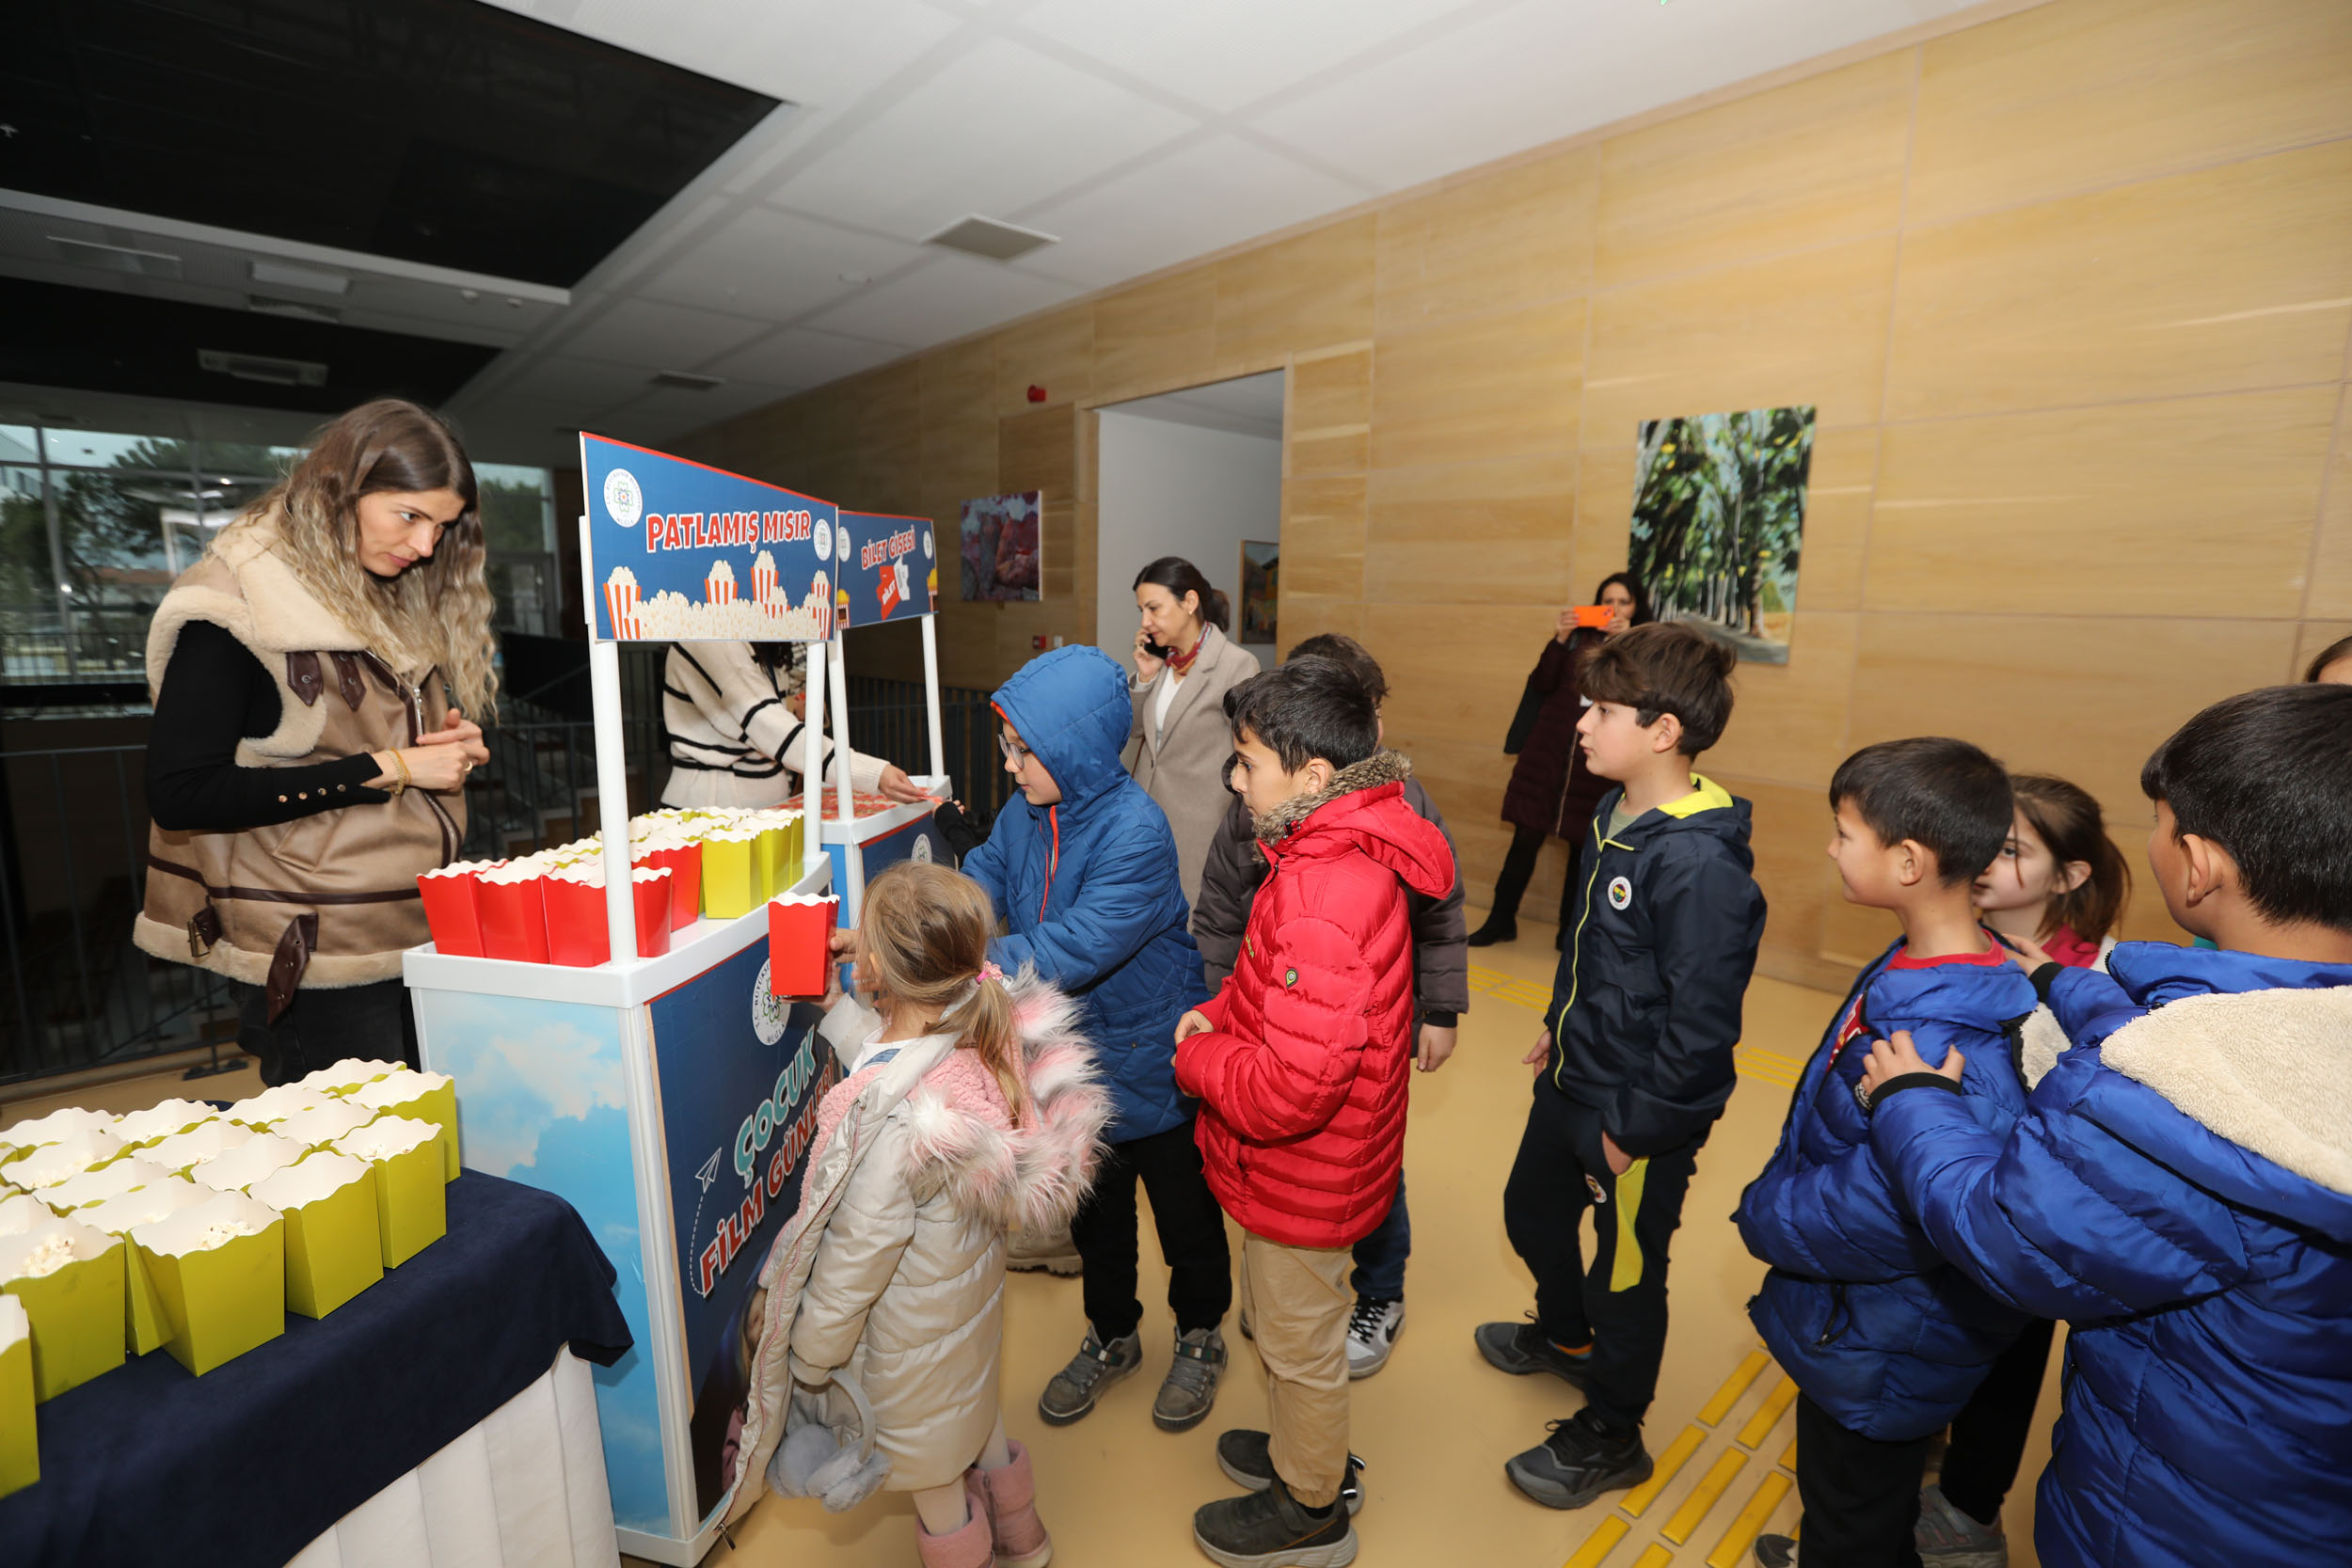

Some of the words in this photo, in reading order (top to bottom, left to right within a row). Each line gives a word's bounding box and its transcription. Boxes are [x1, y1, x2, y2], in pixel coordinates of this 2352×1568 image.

[646, 511, 759, 554] PATLAMIŞ
[762, 510, 811, 544] MISIR
[861, 538, 887, 570] BİLET
[734, 1023, 816, 1189] ÇOCUK
[700, 1176, 764, 1298] FİLM
